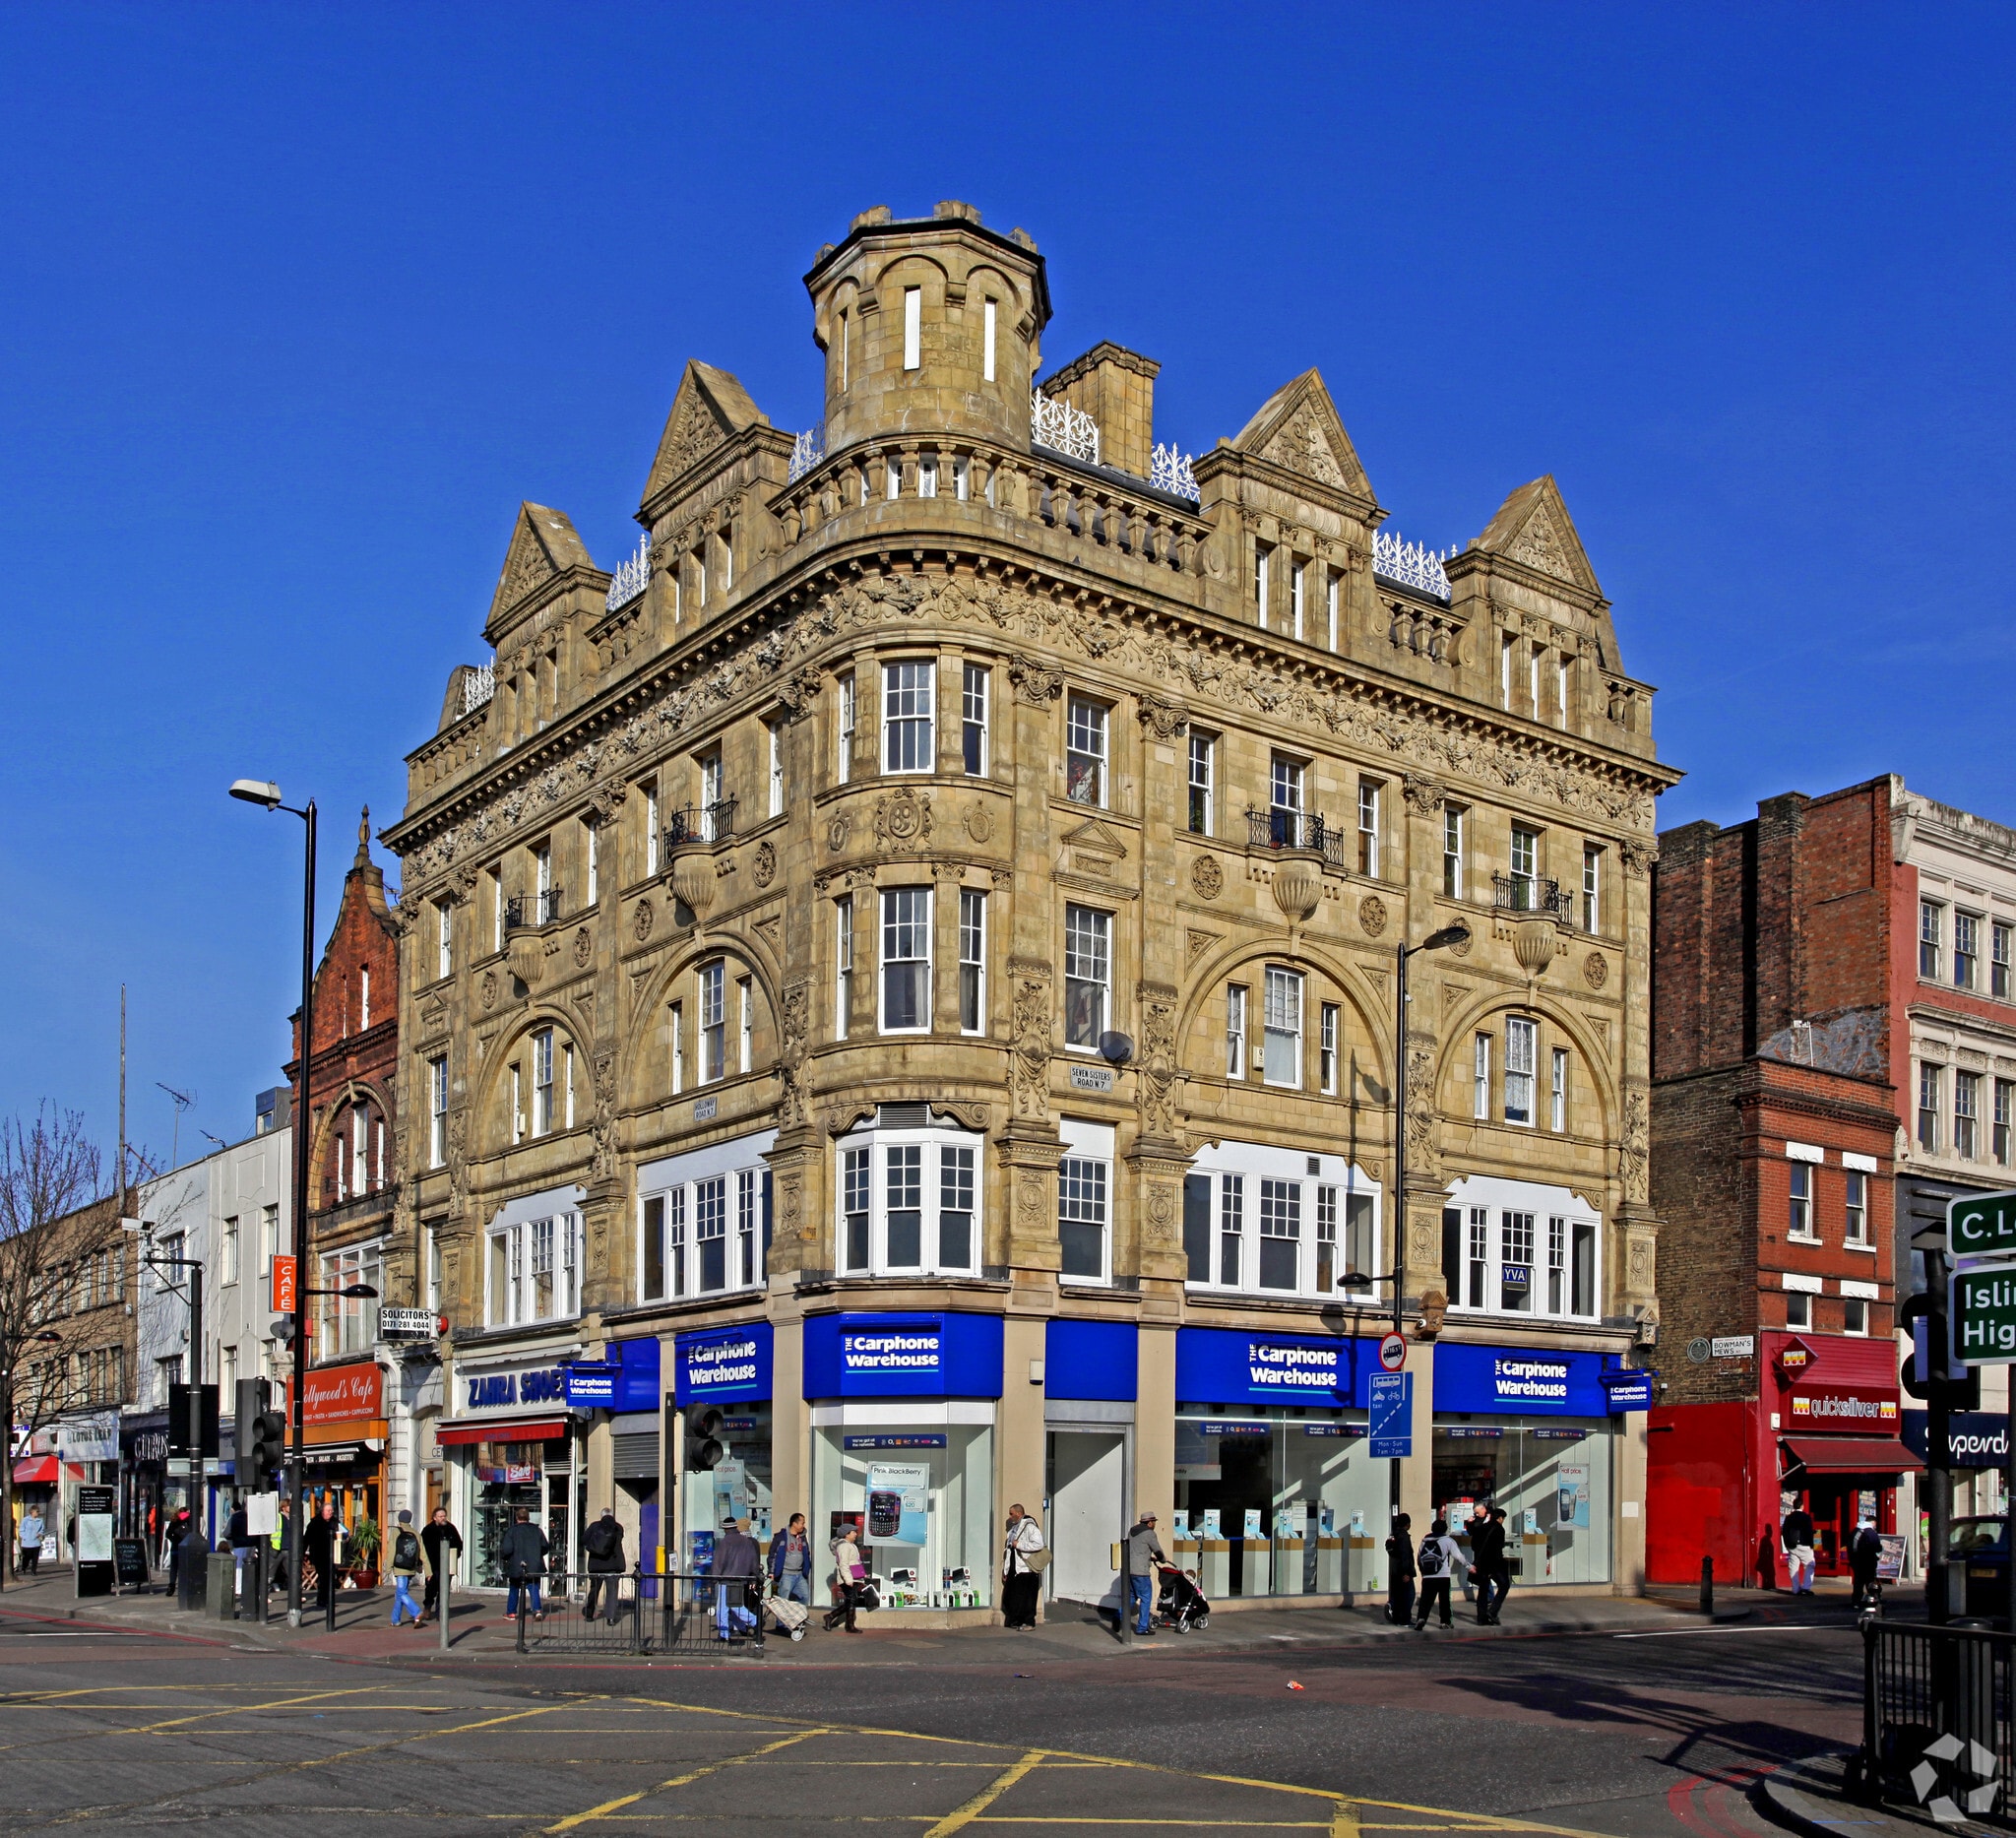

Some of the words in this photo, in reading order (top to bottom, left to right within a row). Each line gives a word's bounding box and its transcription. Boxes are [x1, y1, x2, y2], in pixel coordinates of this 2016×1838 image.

[1072, 1068, 1089, 1078] SEVEN
[1089, 1070, 1111, 1081] SISTERS
[1077, 1078, 1094, 1088] ROAD
[1504, 1268, 1526, 1282] YVA
[1965, 1280, 2016, 1309] Isli
[382, 1309, 429, 1320] SOLICITORS
[695, 1341, 757, 1364] Carphone
[853, 1335, 939, 1353] Carphone
[1714, 1340, 1751, 1349] BOWMAN'S
[846, 1353, 939, 1367] Warehouse
[1257, 1345, 1338, 1367] Carphone
[689, 1364, 757, 1385] Warehouse
[1249, 1366, 1338, 1386] Warehouse
[1502, 1360, 1568, 1380] Carphone
[573, 1378, 612, 1388] Carphone
[1496, 1379, 1568, 1397] Warehouse
[302, 1379, 347, 1410] ollywood's
[350, 1375, 374, 1405] Cafe
[1811, 1395, 1879, 1419] quicksilver
